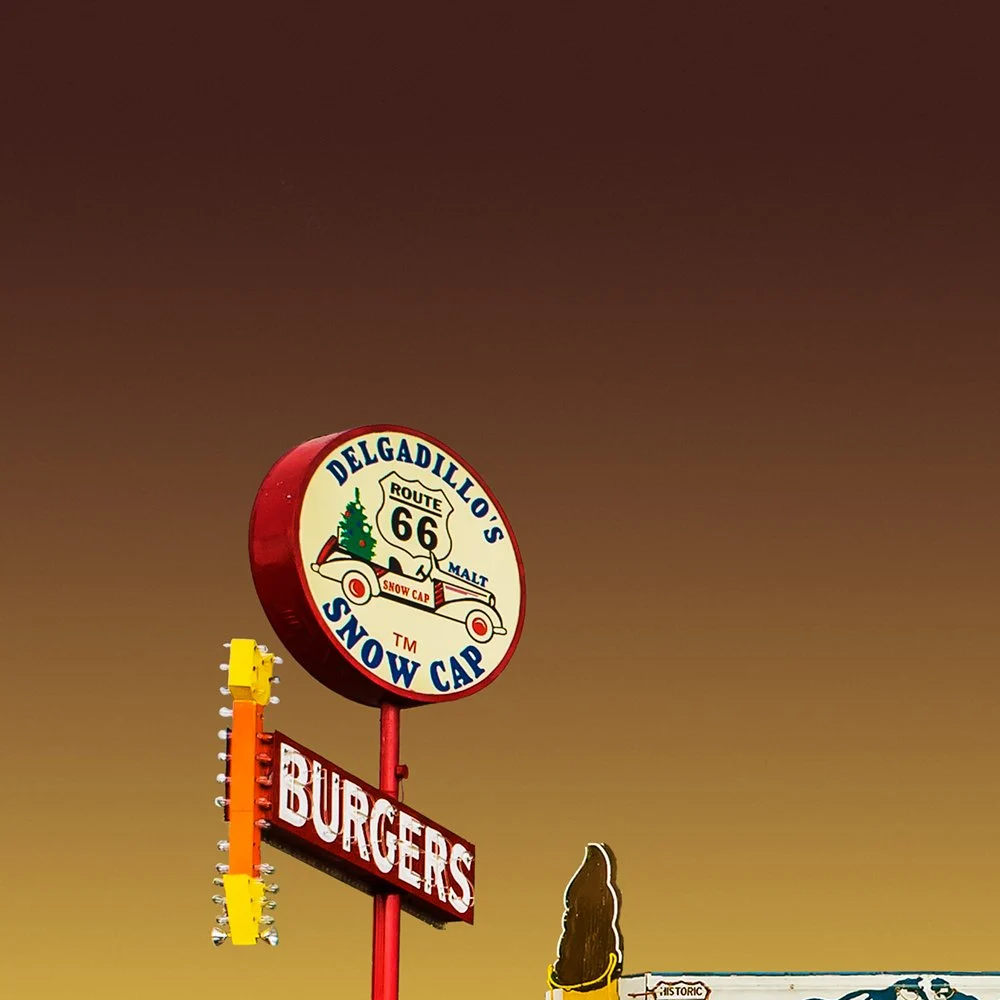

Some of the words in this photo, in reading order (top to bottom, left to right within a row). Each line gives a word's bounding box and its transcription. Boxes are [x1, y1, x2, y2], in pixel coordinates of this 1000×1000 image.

[326, 437, 504, 544] DELGADILLO'S
[390, 481, 443, 512] ROUTE
[391, 506, 438, 551] 66
[448, 562, 489, 588] MALT
[383, 579, 410, 597] SNOW
[412, 590, 430, 603] CAP
[322, 597, 421, 689] SNOW
[430, 645, 486, 692] CAP
[393, 632, 417, 654] TM
[279, 742, 474, 913] BURGERS
[659, 986, 703, 997] HISTORIC
